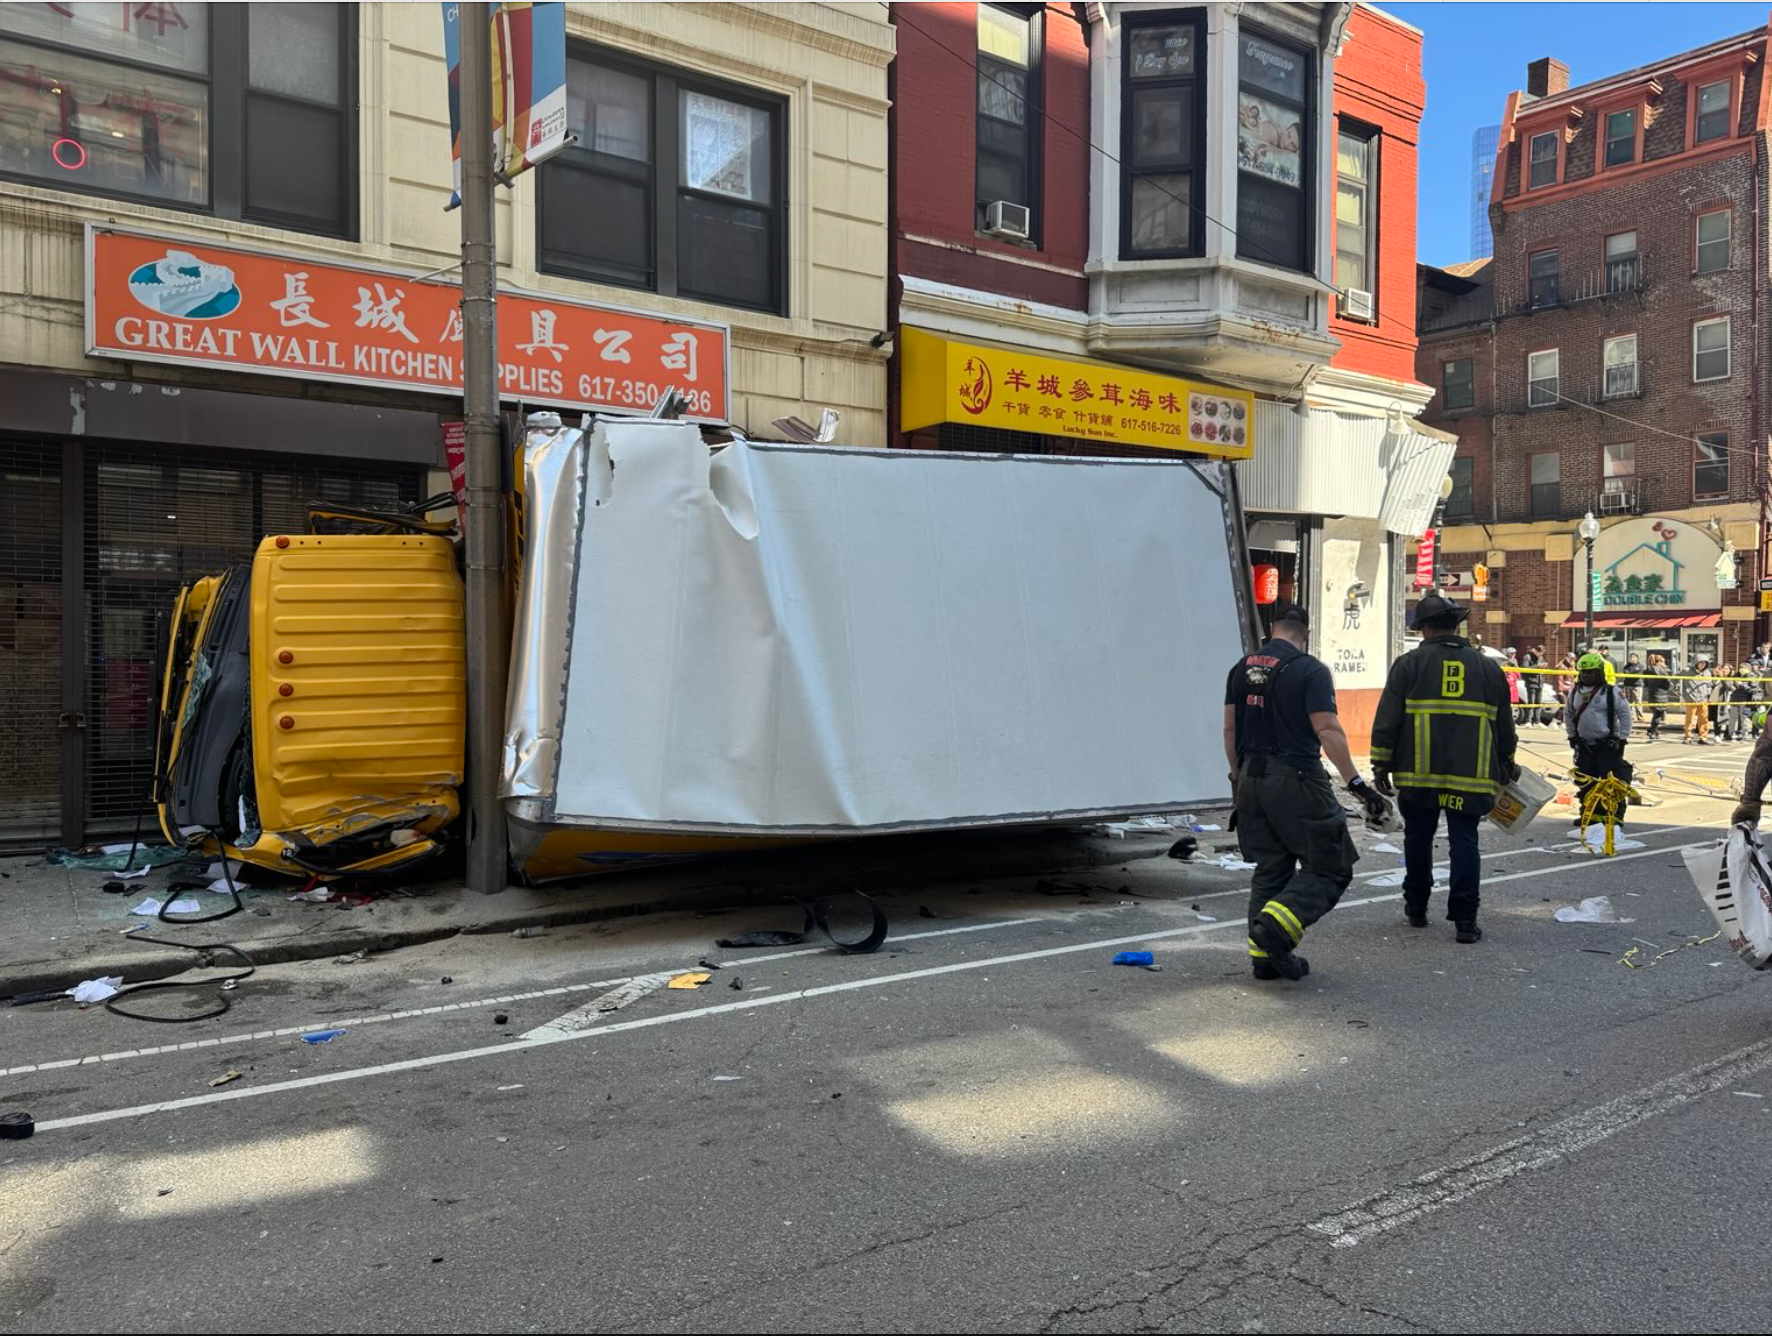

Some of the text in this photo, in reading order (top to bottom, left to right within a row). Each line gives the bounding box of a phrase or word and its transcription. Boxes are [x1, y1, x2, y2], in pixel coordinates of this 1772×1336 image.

[115, 316, 241, 357] GREAT
[250, 332, 345, 369] WALL
[354, 344, 453, 381] KITCHEN
[460, 357, 563, 394] PLIES
[1062, 425, 1118, 438] Lucky Sun Inc.
[1120, 417, 1181, 436] 617-516-7226
[1603, 594, 1685, 606] DOUBLE CHIN
